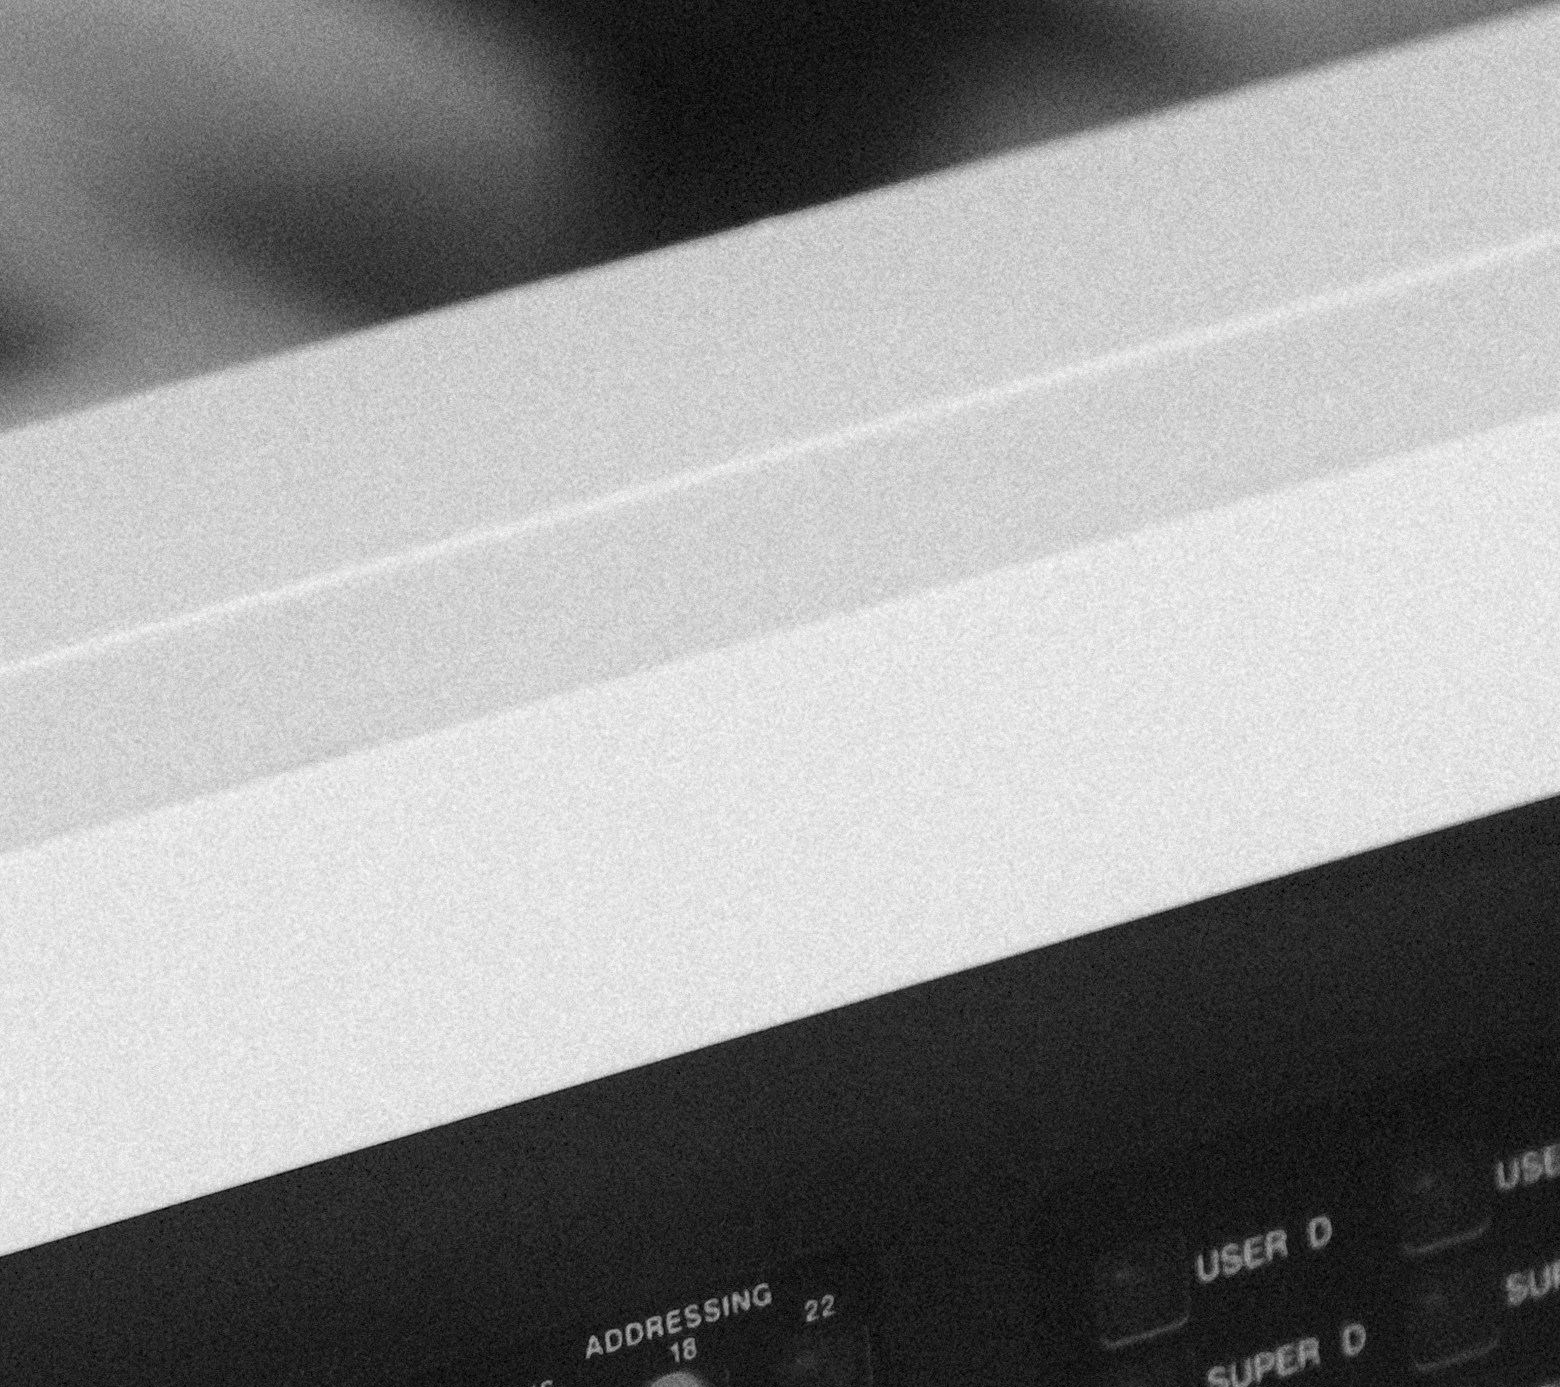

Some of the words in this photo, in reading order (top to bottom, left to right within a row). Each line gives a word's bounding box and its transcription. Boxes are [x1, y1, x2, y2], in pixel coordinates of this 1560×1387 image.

[1195, 1228, 1288, 1283] USER
[1306, 1215, 1333, 1250] D
[585, 1282, 773, 1363] ADDRESSING
[669, 1336, 698, 1363] 18
[804, 1293, 835, 1324] 22
[1341, 1322, 1367, 1357] D
